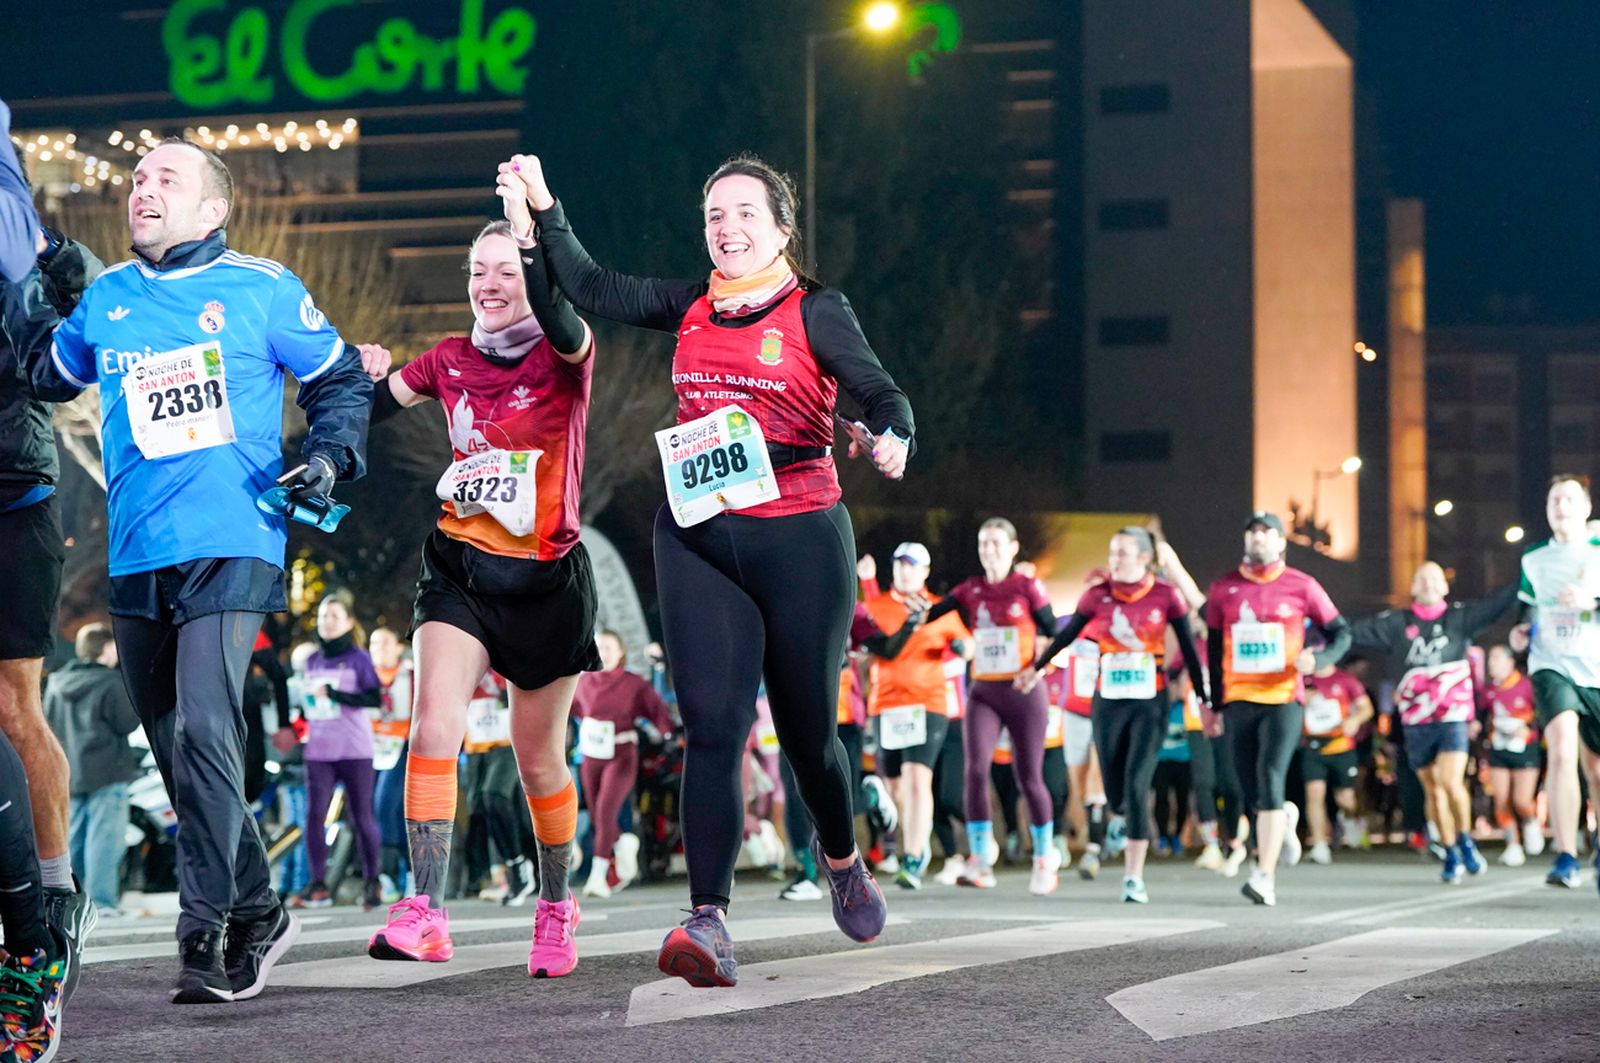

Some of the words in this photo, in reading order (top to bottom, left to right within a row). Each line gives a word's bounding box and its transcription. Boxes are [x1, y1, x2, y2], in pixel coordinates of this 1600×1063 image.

[162, 0, 274, 108] El
[281, 0, 536, 99] Corte
[148, 361, 179, 377] NOCHE
[181, 358, 193, 369] DE
[138, 378, 158, 393] SAN
[160, 371, 196, 388] ANTON
[725, 374, 787, 392] RUNNING
[148, 379, 223, 421] 2338
[703, 391, 753, 400] ATLETISMO
[681, 427, 708, 446] NOCHE
[708, 422, 719, 435] DE
[672, 446, 691, 462] SAN
[691, 435, 721, 455] ANTON
[681, 442, 749, 489] 9298
[453, 476, 518, 503] 3323
